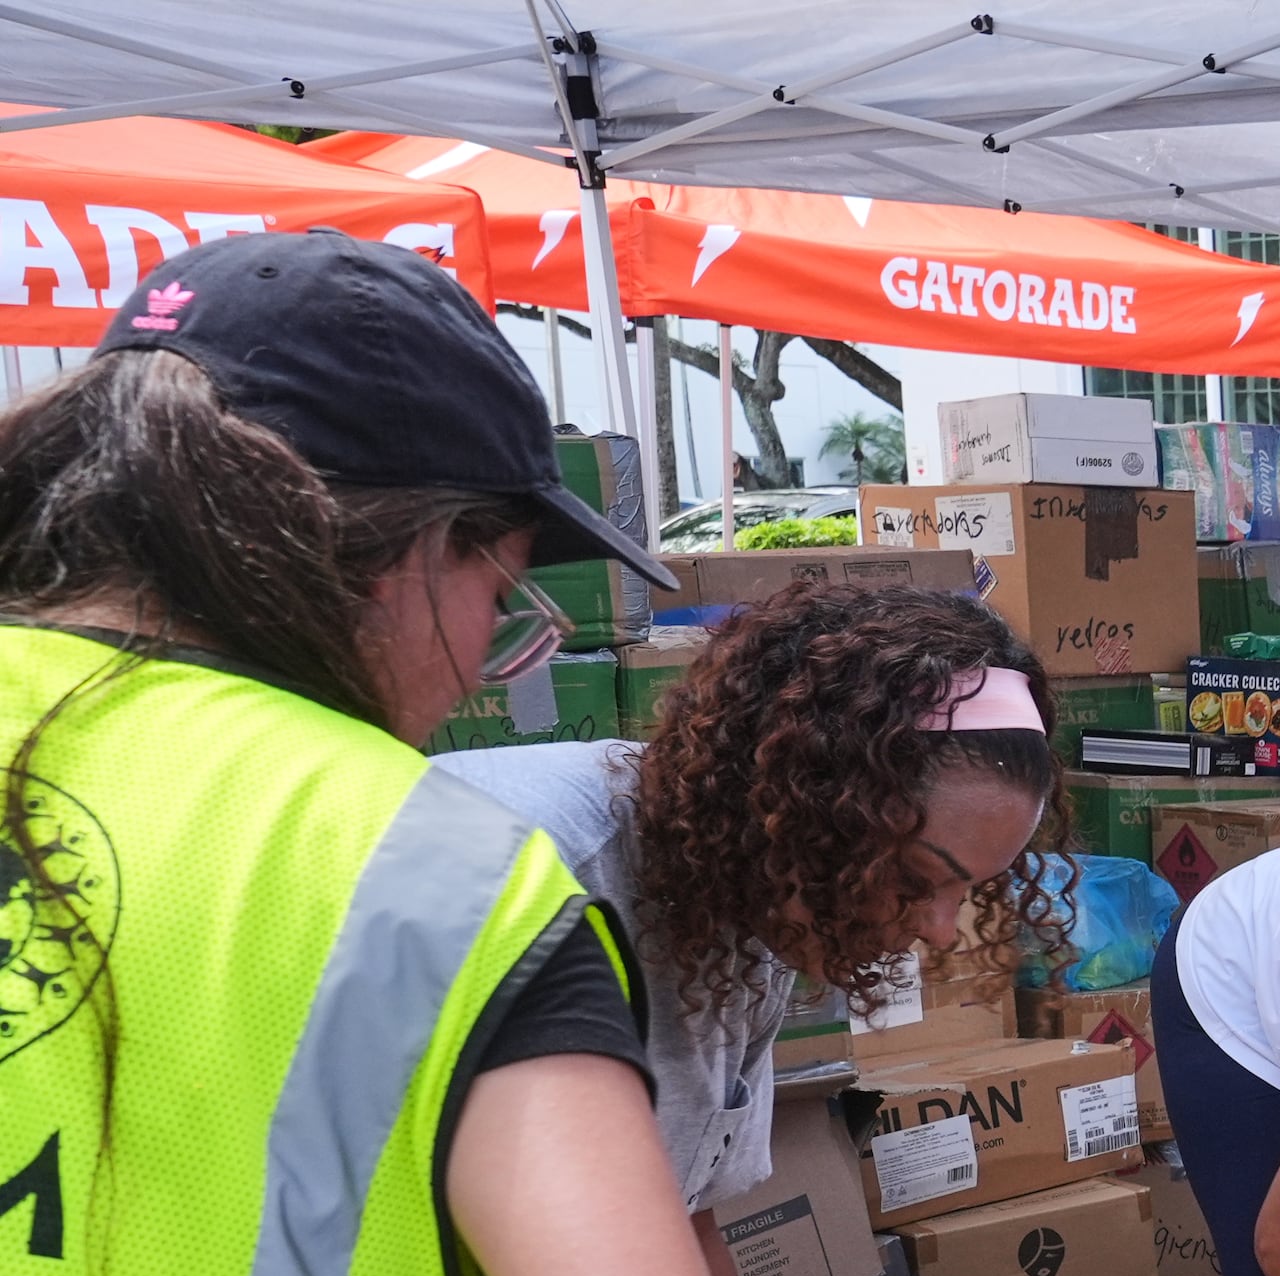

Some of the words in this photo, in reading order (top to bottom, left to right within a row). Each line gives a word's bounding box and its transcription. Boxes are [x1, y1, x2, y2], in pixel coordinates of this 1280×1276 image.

[880, 256, 1137, 334] GATORADE
[1258, 449, 1274, 517] always
[1191, 672, 1239, 689] CRACKER
[731, 1210, 784, 1238] FRAGILE
[737, 1237, 775, 1257] KITCHEN
[740, 1248, 781, 1268] LAUNDRY
